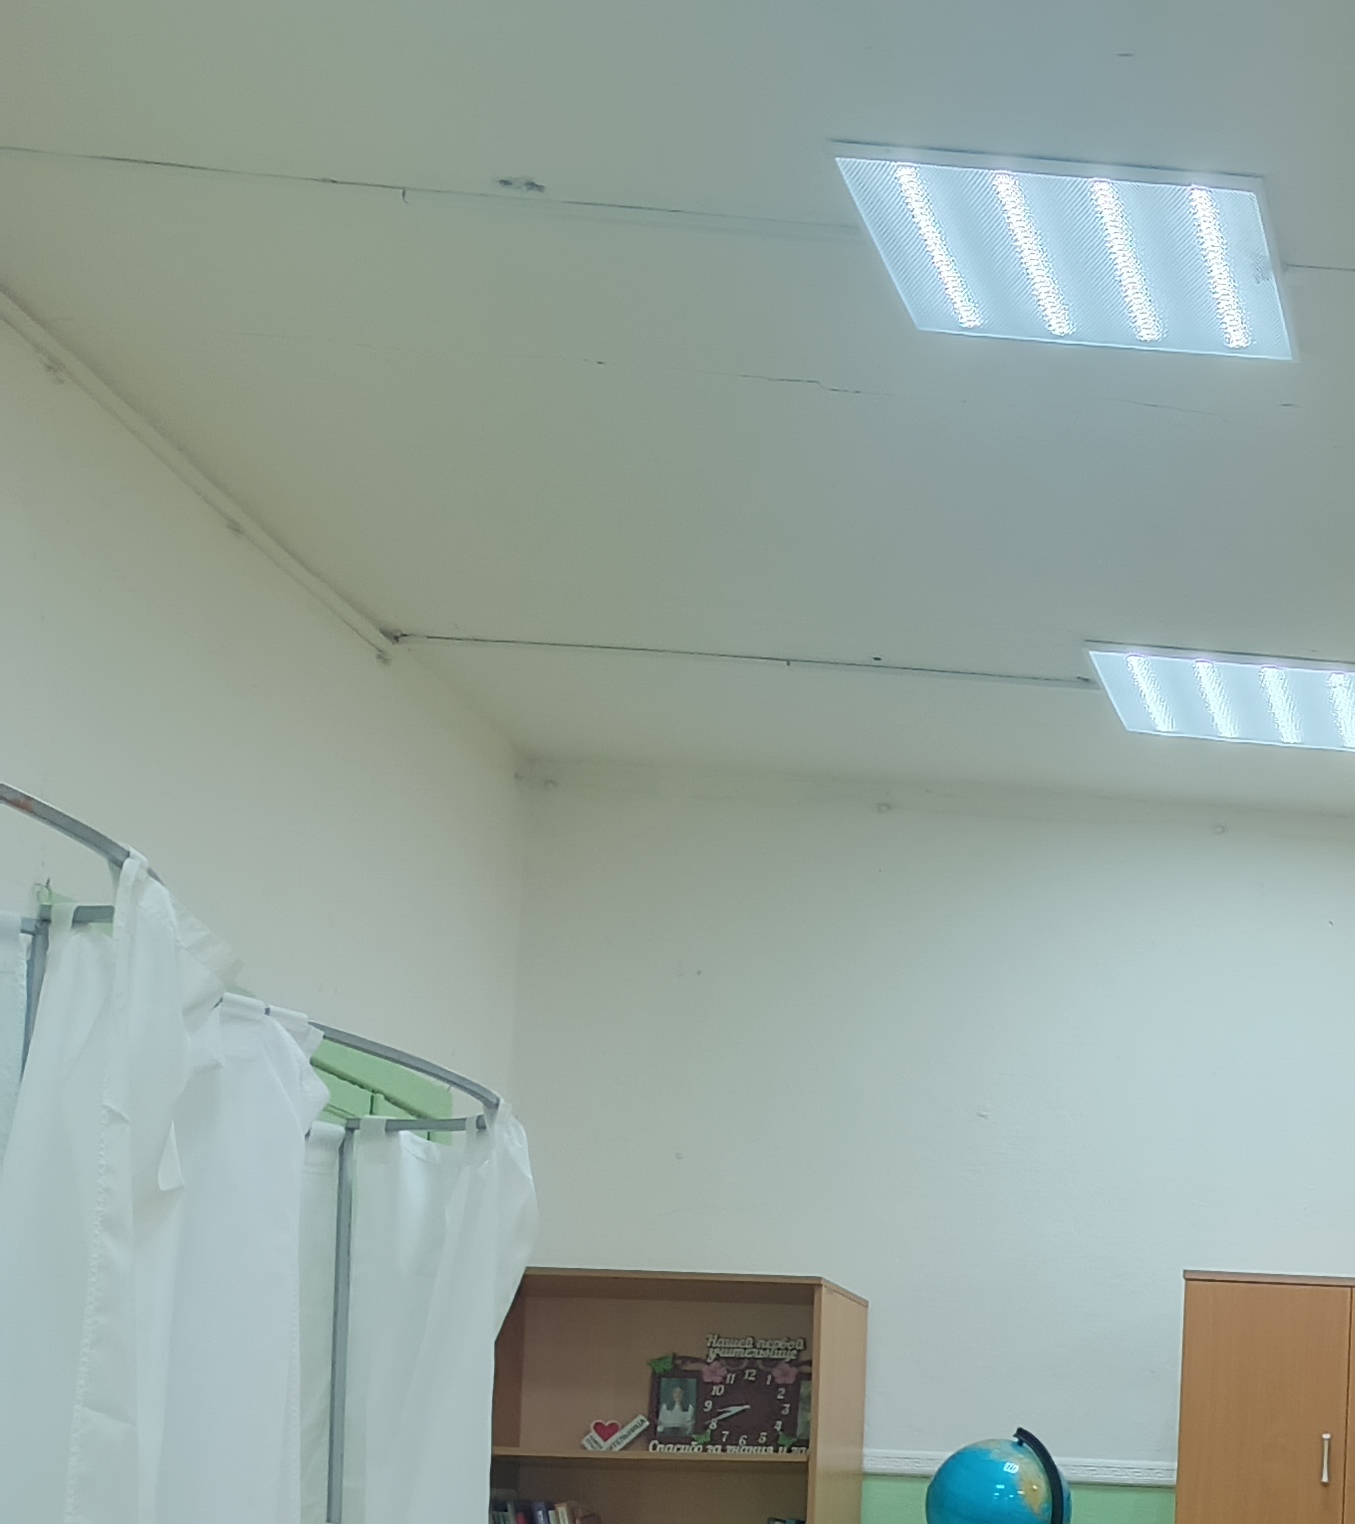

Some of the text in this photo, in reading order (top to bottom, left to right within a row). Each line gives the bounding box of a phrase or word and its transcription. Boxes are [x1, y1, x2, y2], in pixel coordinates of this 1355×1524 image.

[707, 1334, 805, 1351] Нашей первой
[707, 1347, 797, 1362] учительнице
[726, 1373, 736, 1384] 11
[744, 1369, 757, 1380] 12
[766, 1374, 772, 1385] 1
[711, 1385, 725, 1396] 10
[776, 1388, 786, 1399] 2
[703, 1400, 713, 1412] 9
[781, 1403, 791, 1415] 3
[709, 1419, 718, 1430] 8
[774, 1421, 783, 1431] 4
[722, 1431, 730, 1442] 7
[739, 1435, 748, 1446] 6
[758, 1432, 768, 1443] 5
[649, 1439, 703, 1453] Спасибо
